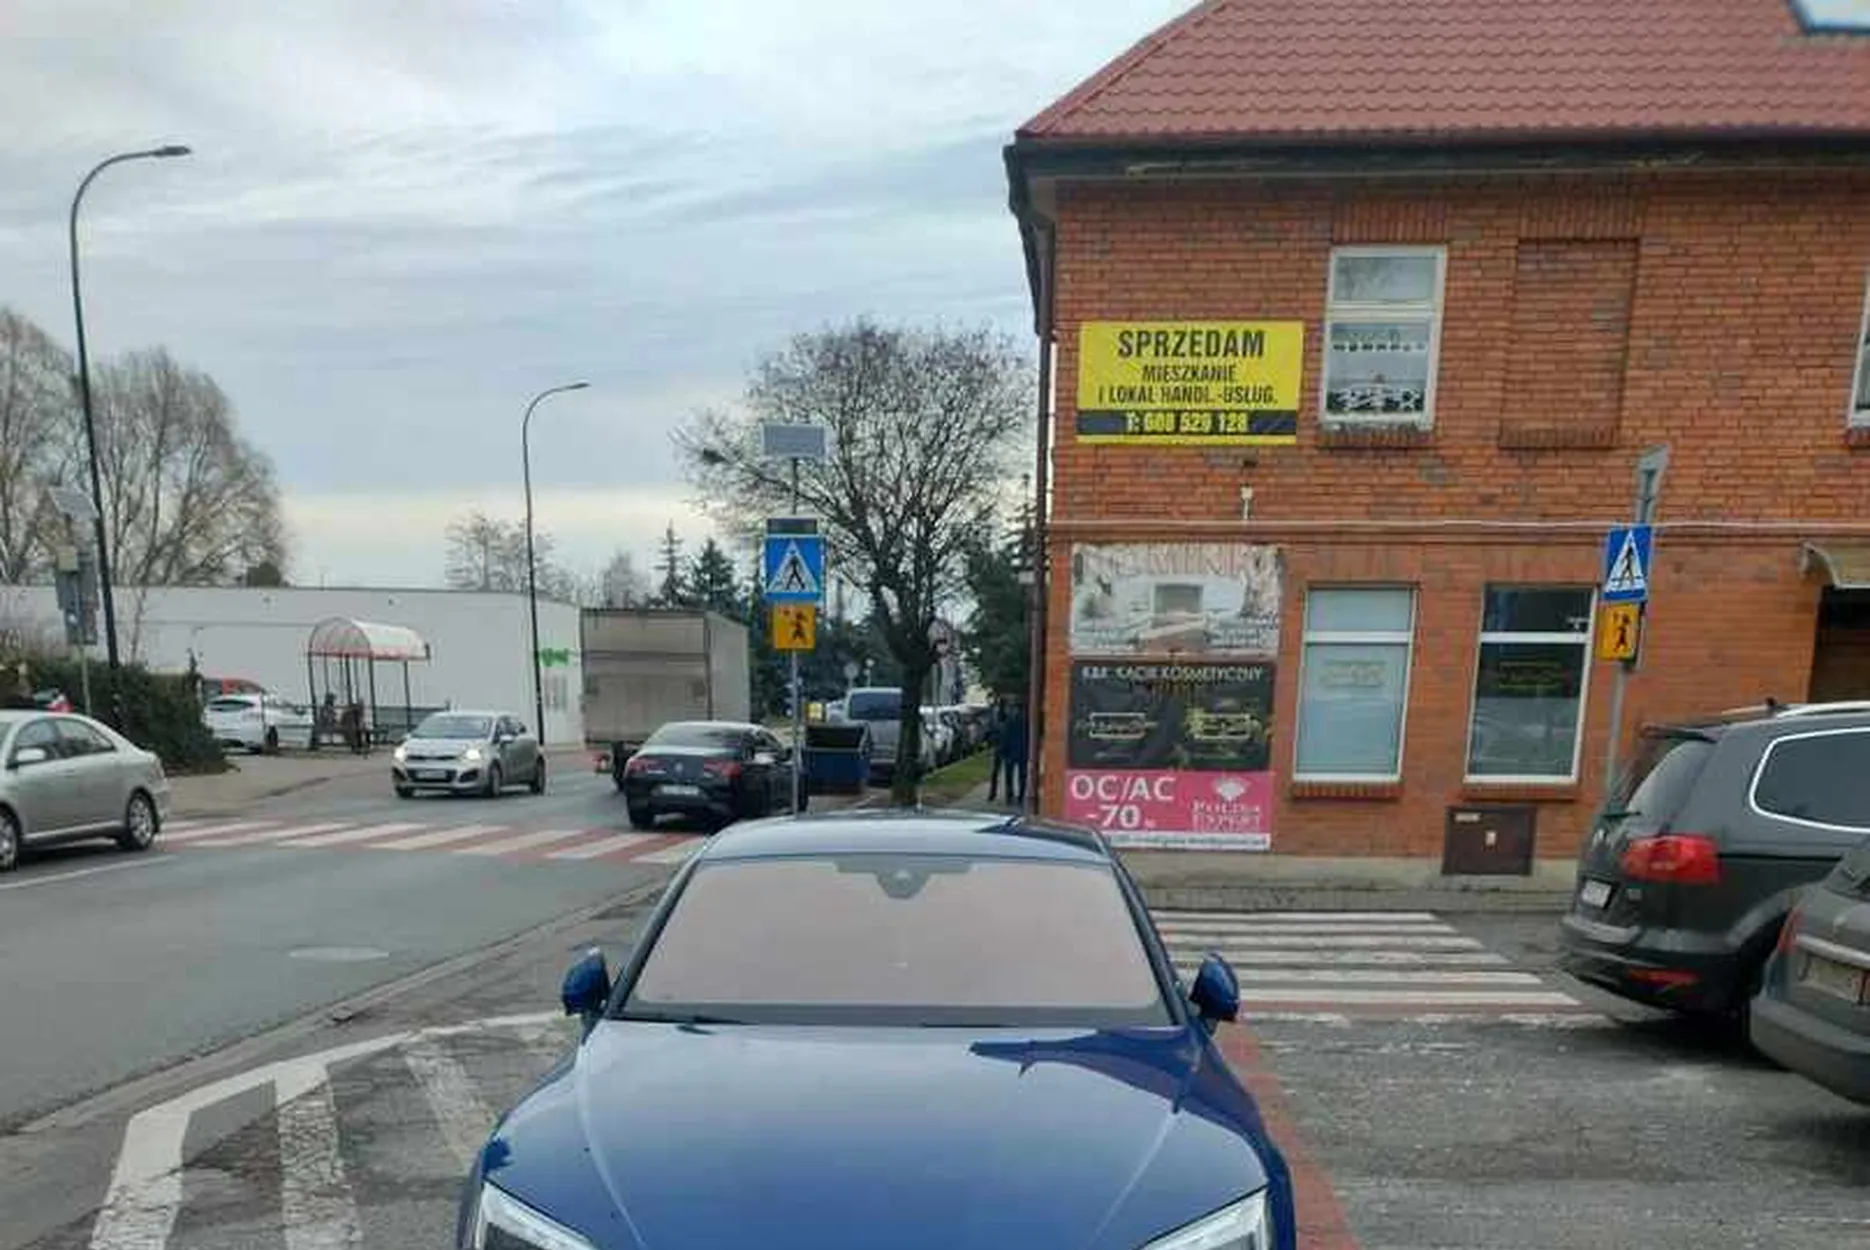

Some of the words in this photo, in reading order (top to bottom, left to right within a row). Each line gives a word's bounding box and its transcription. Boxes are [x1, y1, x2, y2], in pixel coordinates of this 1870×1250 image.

[1118, 330, 1266, 359] SPRZEDAM
[1142, 363, 1238, 383] MIESZKANIE
[1109, 386, 1157, 404] LOKAL
[1070, 775, 1177, 802] OC/AC
